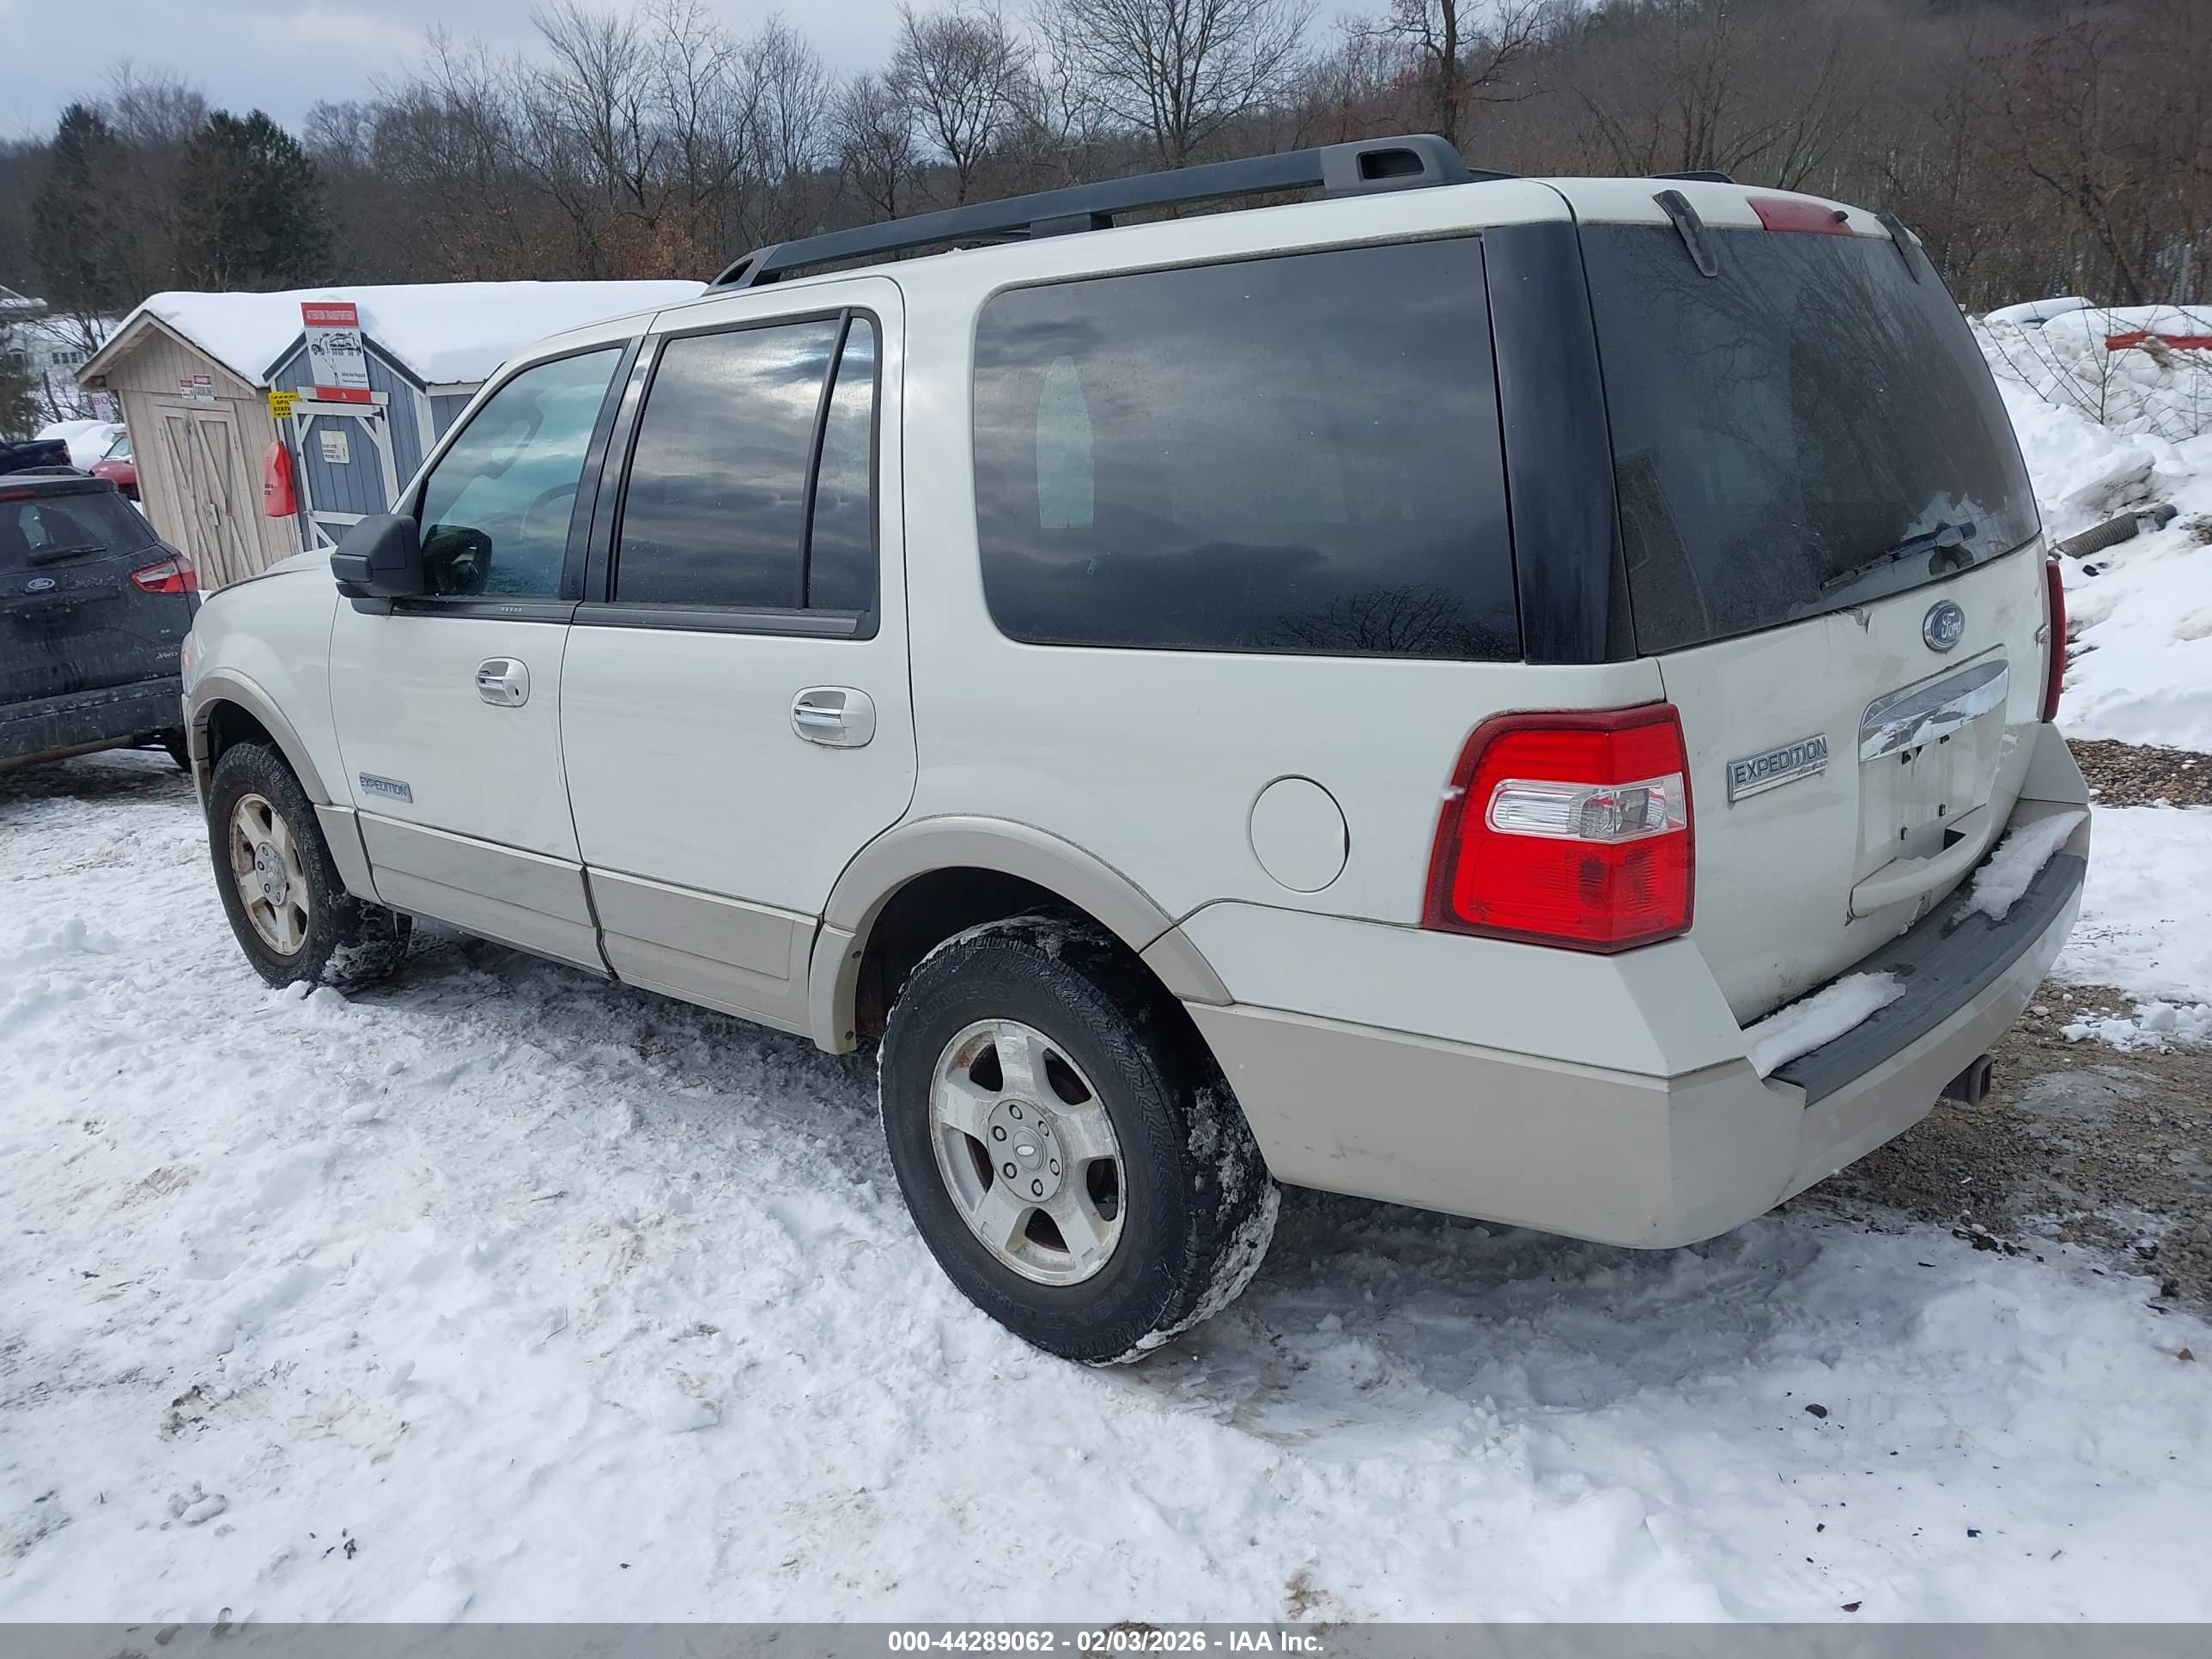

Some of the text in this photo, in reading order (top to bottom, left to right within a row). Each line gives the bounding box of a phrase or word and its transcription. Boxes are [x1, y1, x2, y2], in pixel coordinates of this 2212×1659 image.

[1942, 611, 1961, 639] Ford
[1735, 735, 1828, 785] EXPEDITION
[359, 776, 408, 797] EXPEDITION
